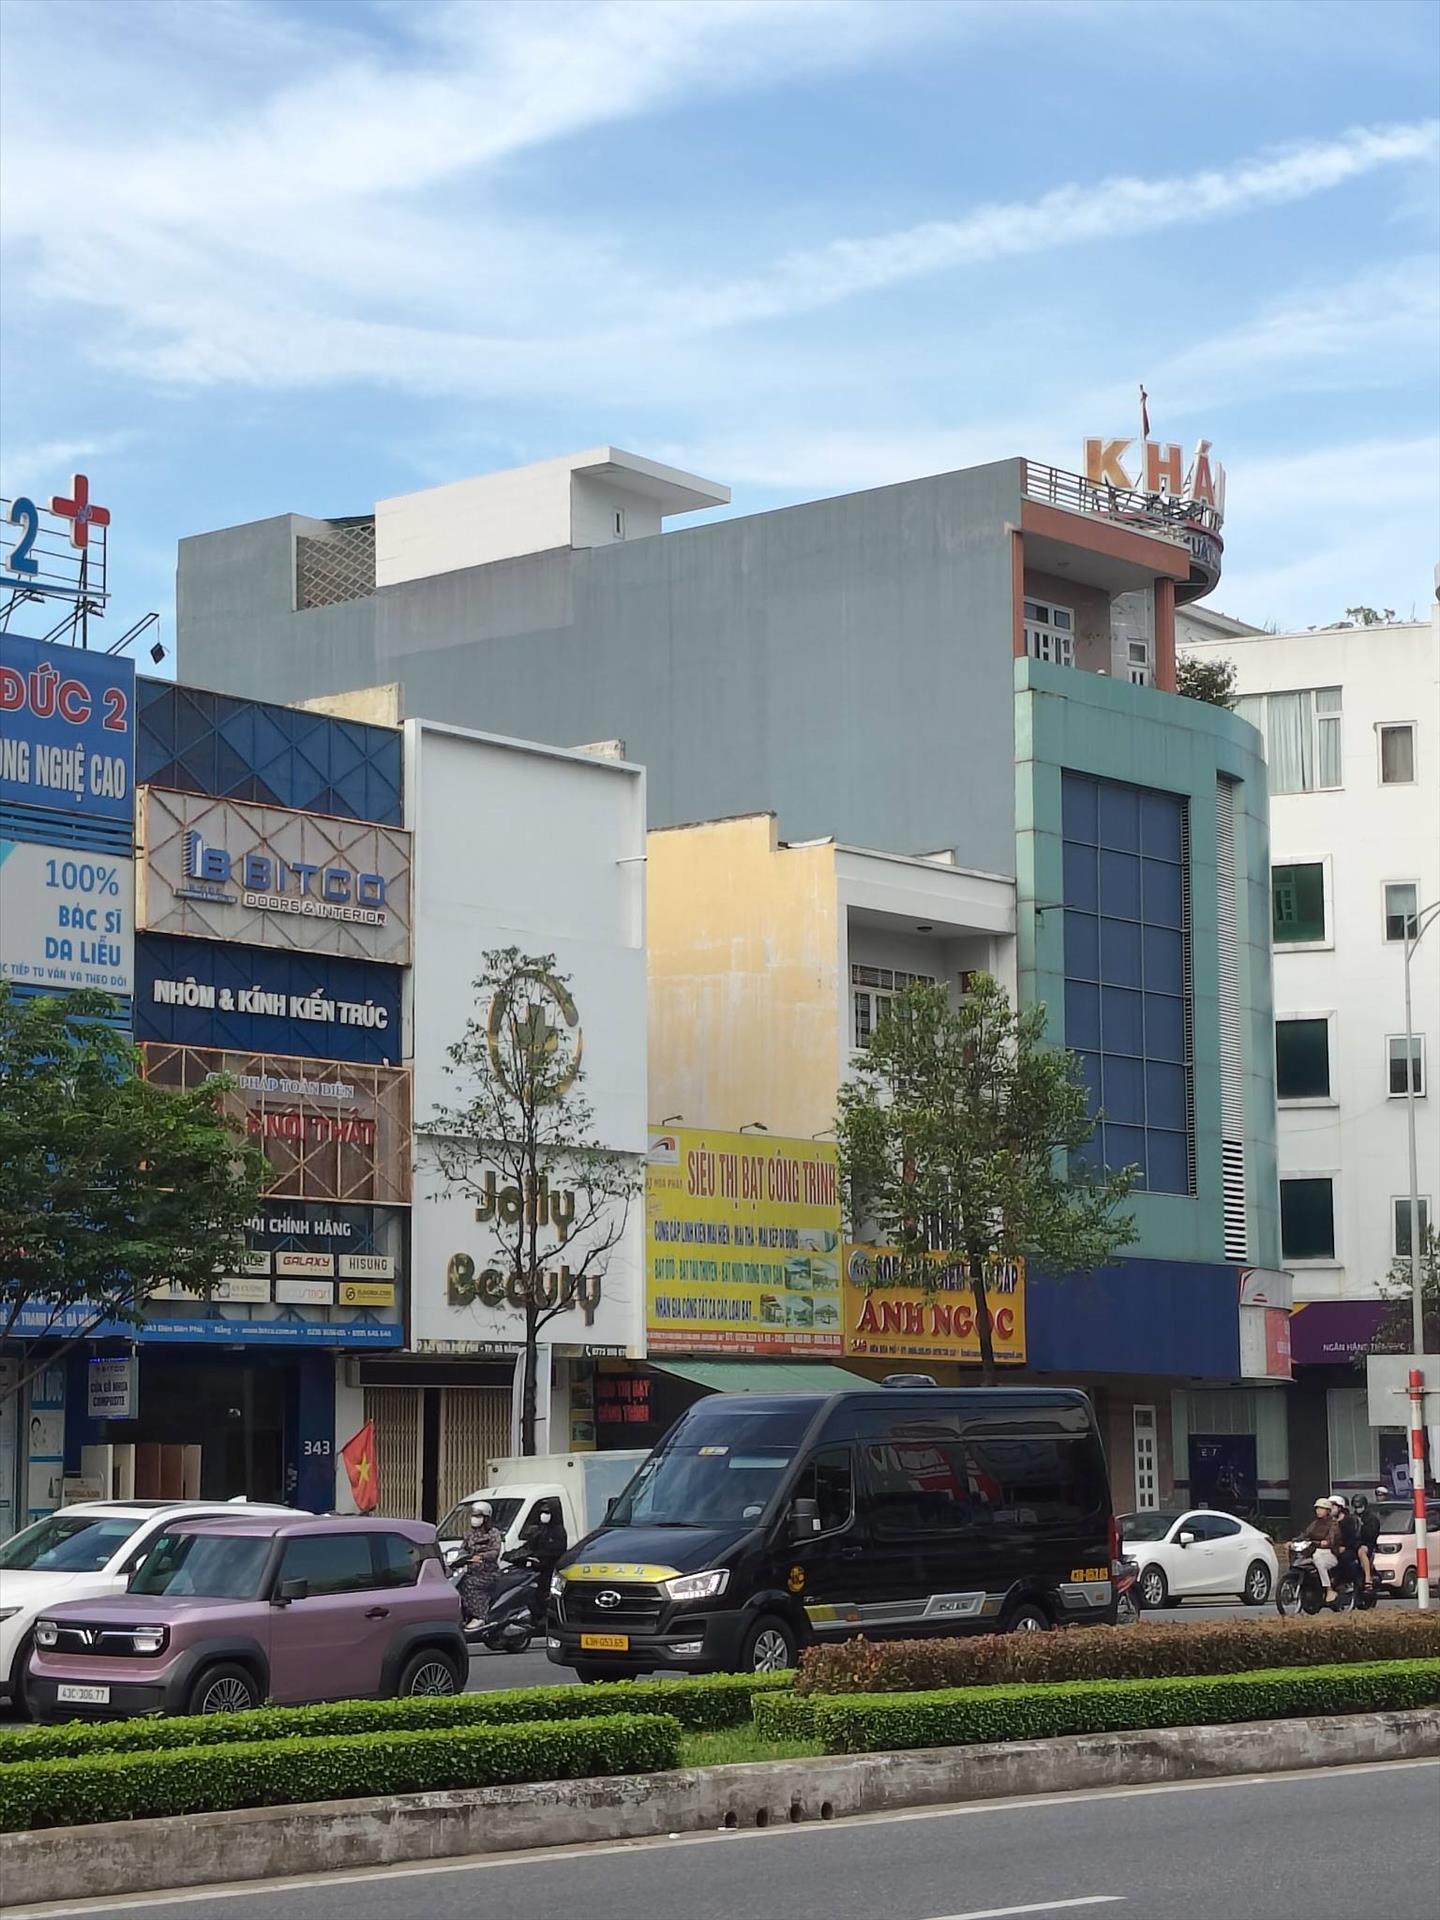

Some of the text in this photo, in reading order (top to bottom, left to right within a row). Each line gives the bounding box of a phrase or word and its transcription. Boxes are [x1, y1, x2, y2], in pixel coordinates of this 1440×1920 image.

[6, 497, 39, 576] 2
[103, 687, 128, 733] 2
[0, 738, 126, 802] NG NGHỆ CAO
[46, 859, 119, 896] 100%
[242, 853, 386, 908] BITCO
[59, 902, 122, 934] BÁC SĨ
[246, 893, 300, 914] DOORS
[303, 901, 315, 915] &
[317, 904, 388, 926] INTERIOR
[45, 935, 121, 967] DA LIỄU
[153, 977, 388, 1030] NHÔM & KÍNH KIẾN TRÚC
[687, 1142, 716, 1197] SIÊU
[719, 1153, 740, 1209] THỊ
[742, 1156, 764, 1211] BẠT
[767, 1149, 800, 1204] CÔNG
[269, 1212, 310, 1235] CHÍNH
[314, 1216, 351, 1236] HÃNG
[475, 1170, 575, 1242] Jolly
[283, 1256, 331, 1267] GALAXY
[447, 1252, 601, 1327] Beauty
[304, 1440, 330, 1455] 343
